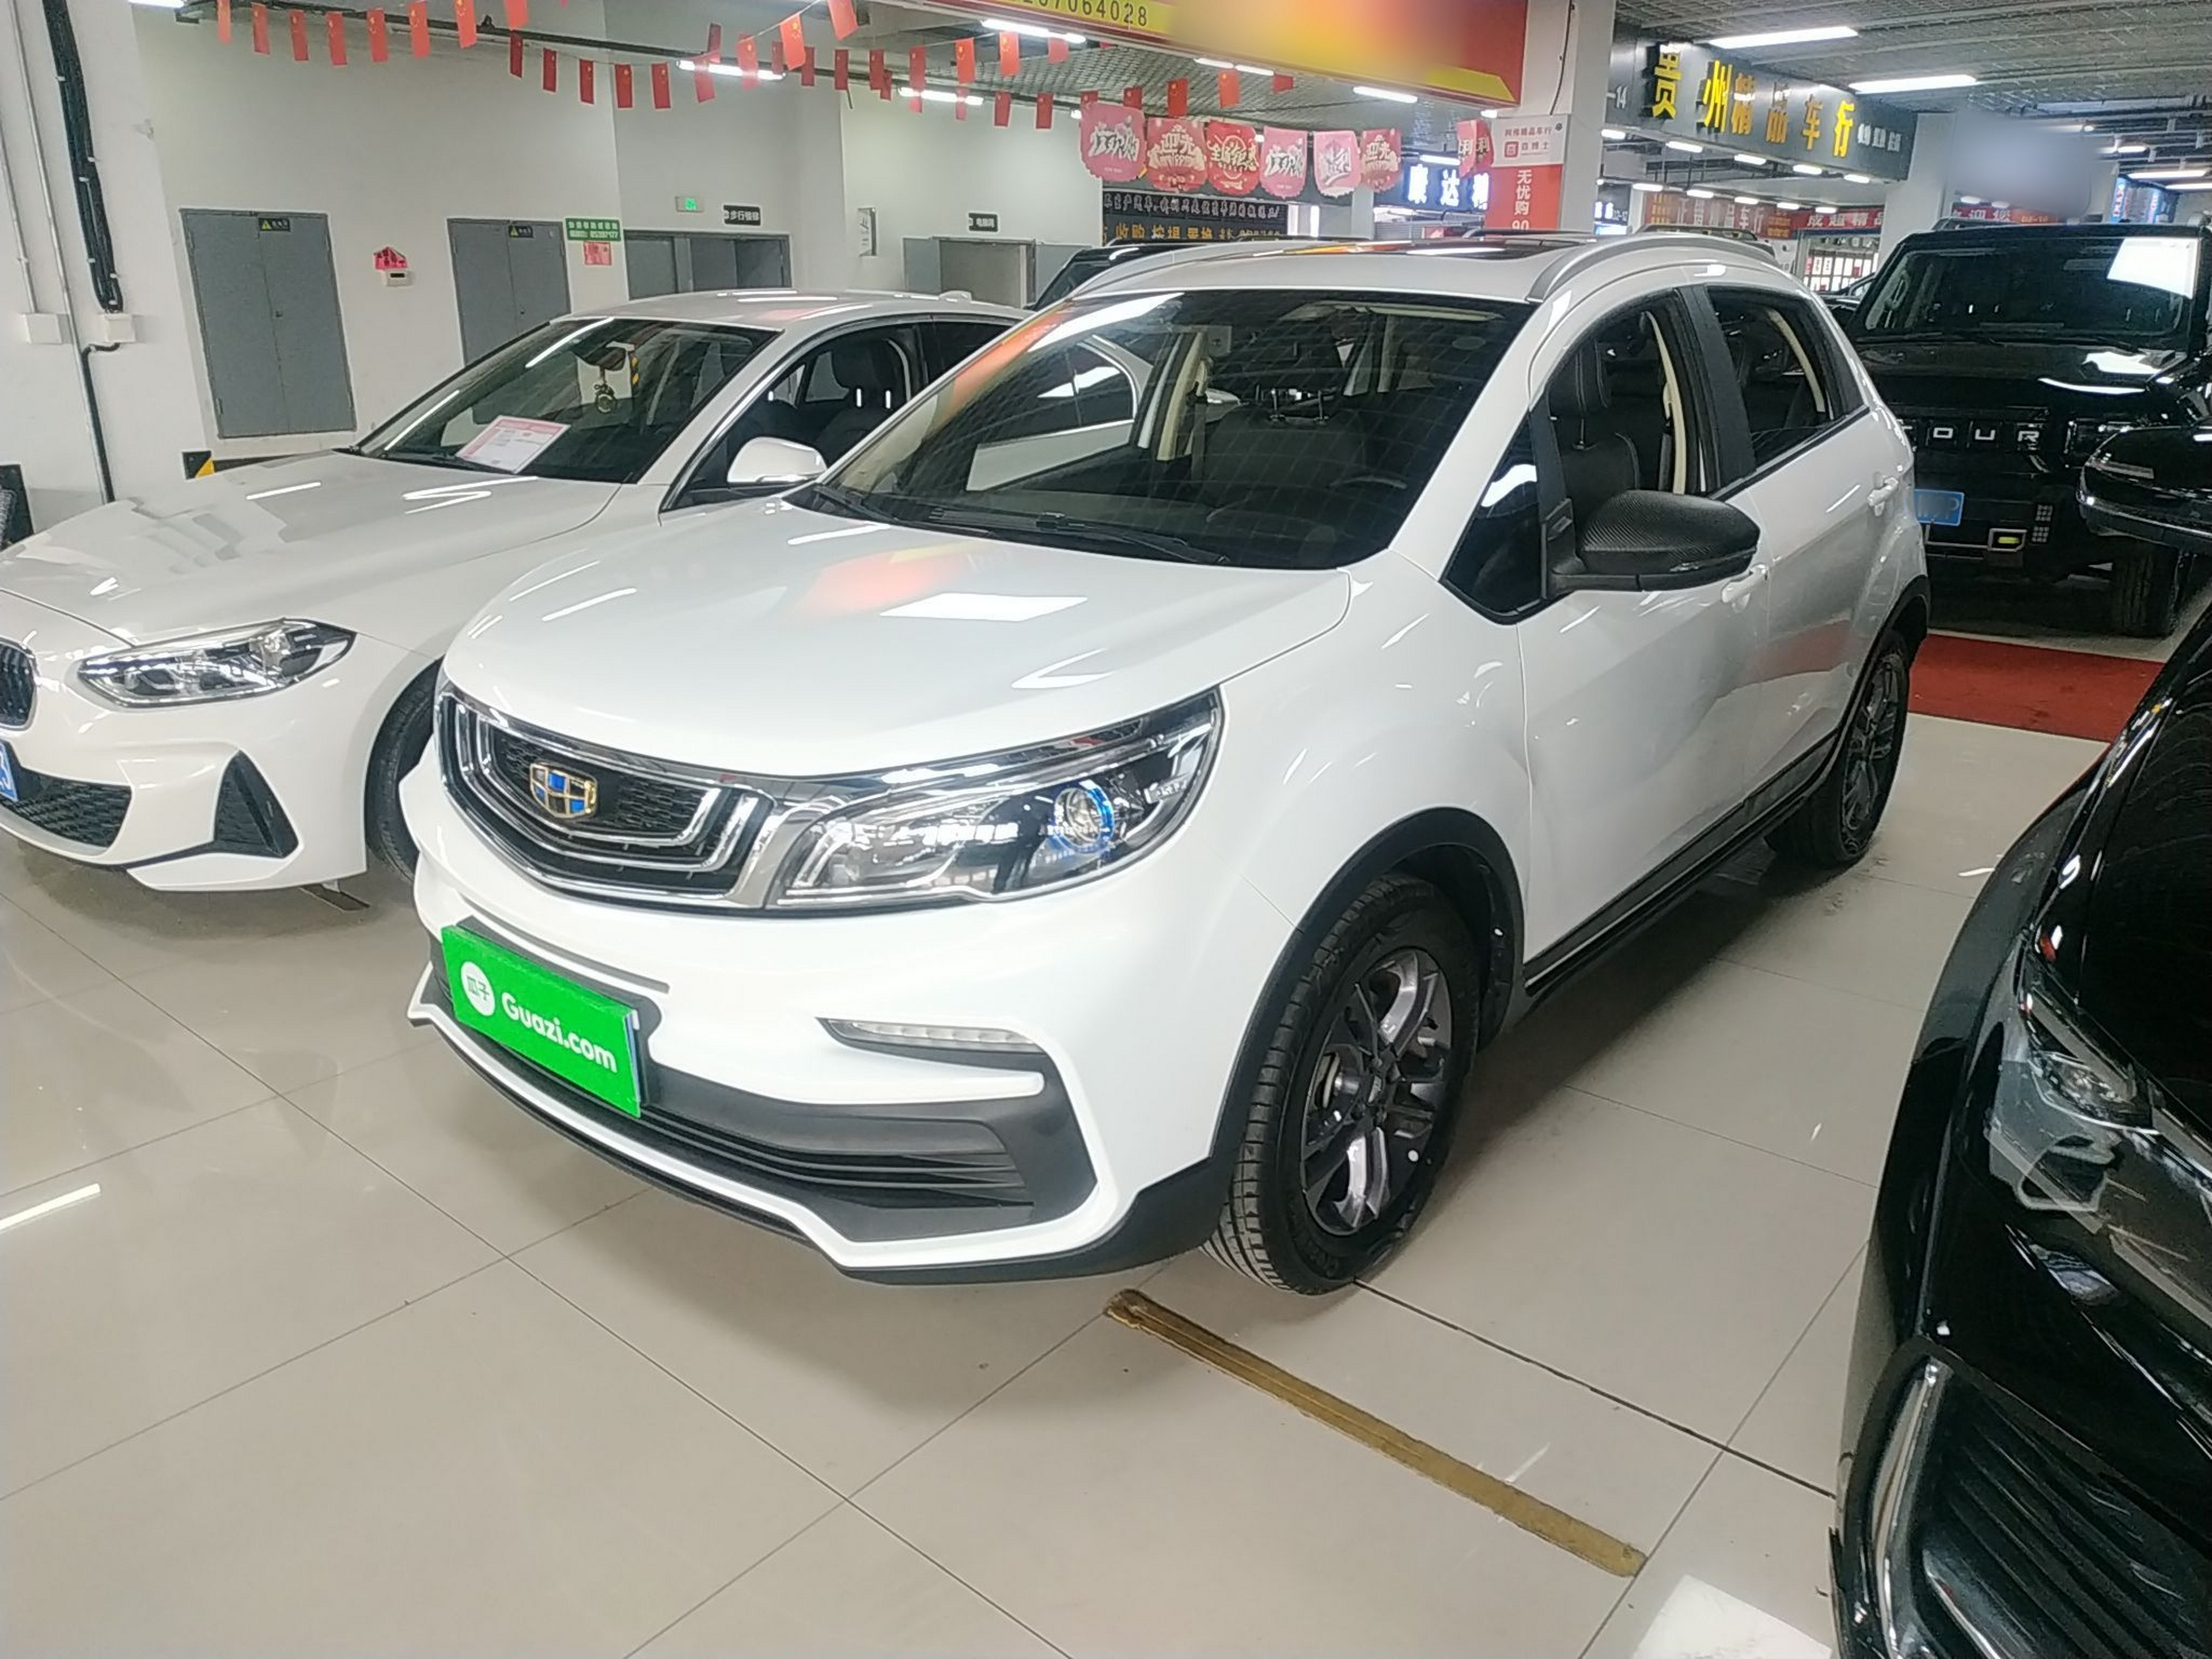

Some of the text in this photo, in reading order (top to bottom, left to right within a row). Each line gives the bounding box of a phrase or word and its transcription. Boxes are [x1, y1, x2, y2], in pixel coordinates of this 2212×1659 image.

[1652, 44, 1855, 157] 贵州精品车行
[502, 991, 618, 1073] Guazi.com
